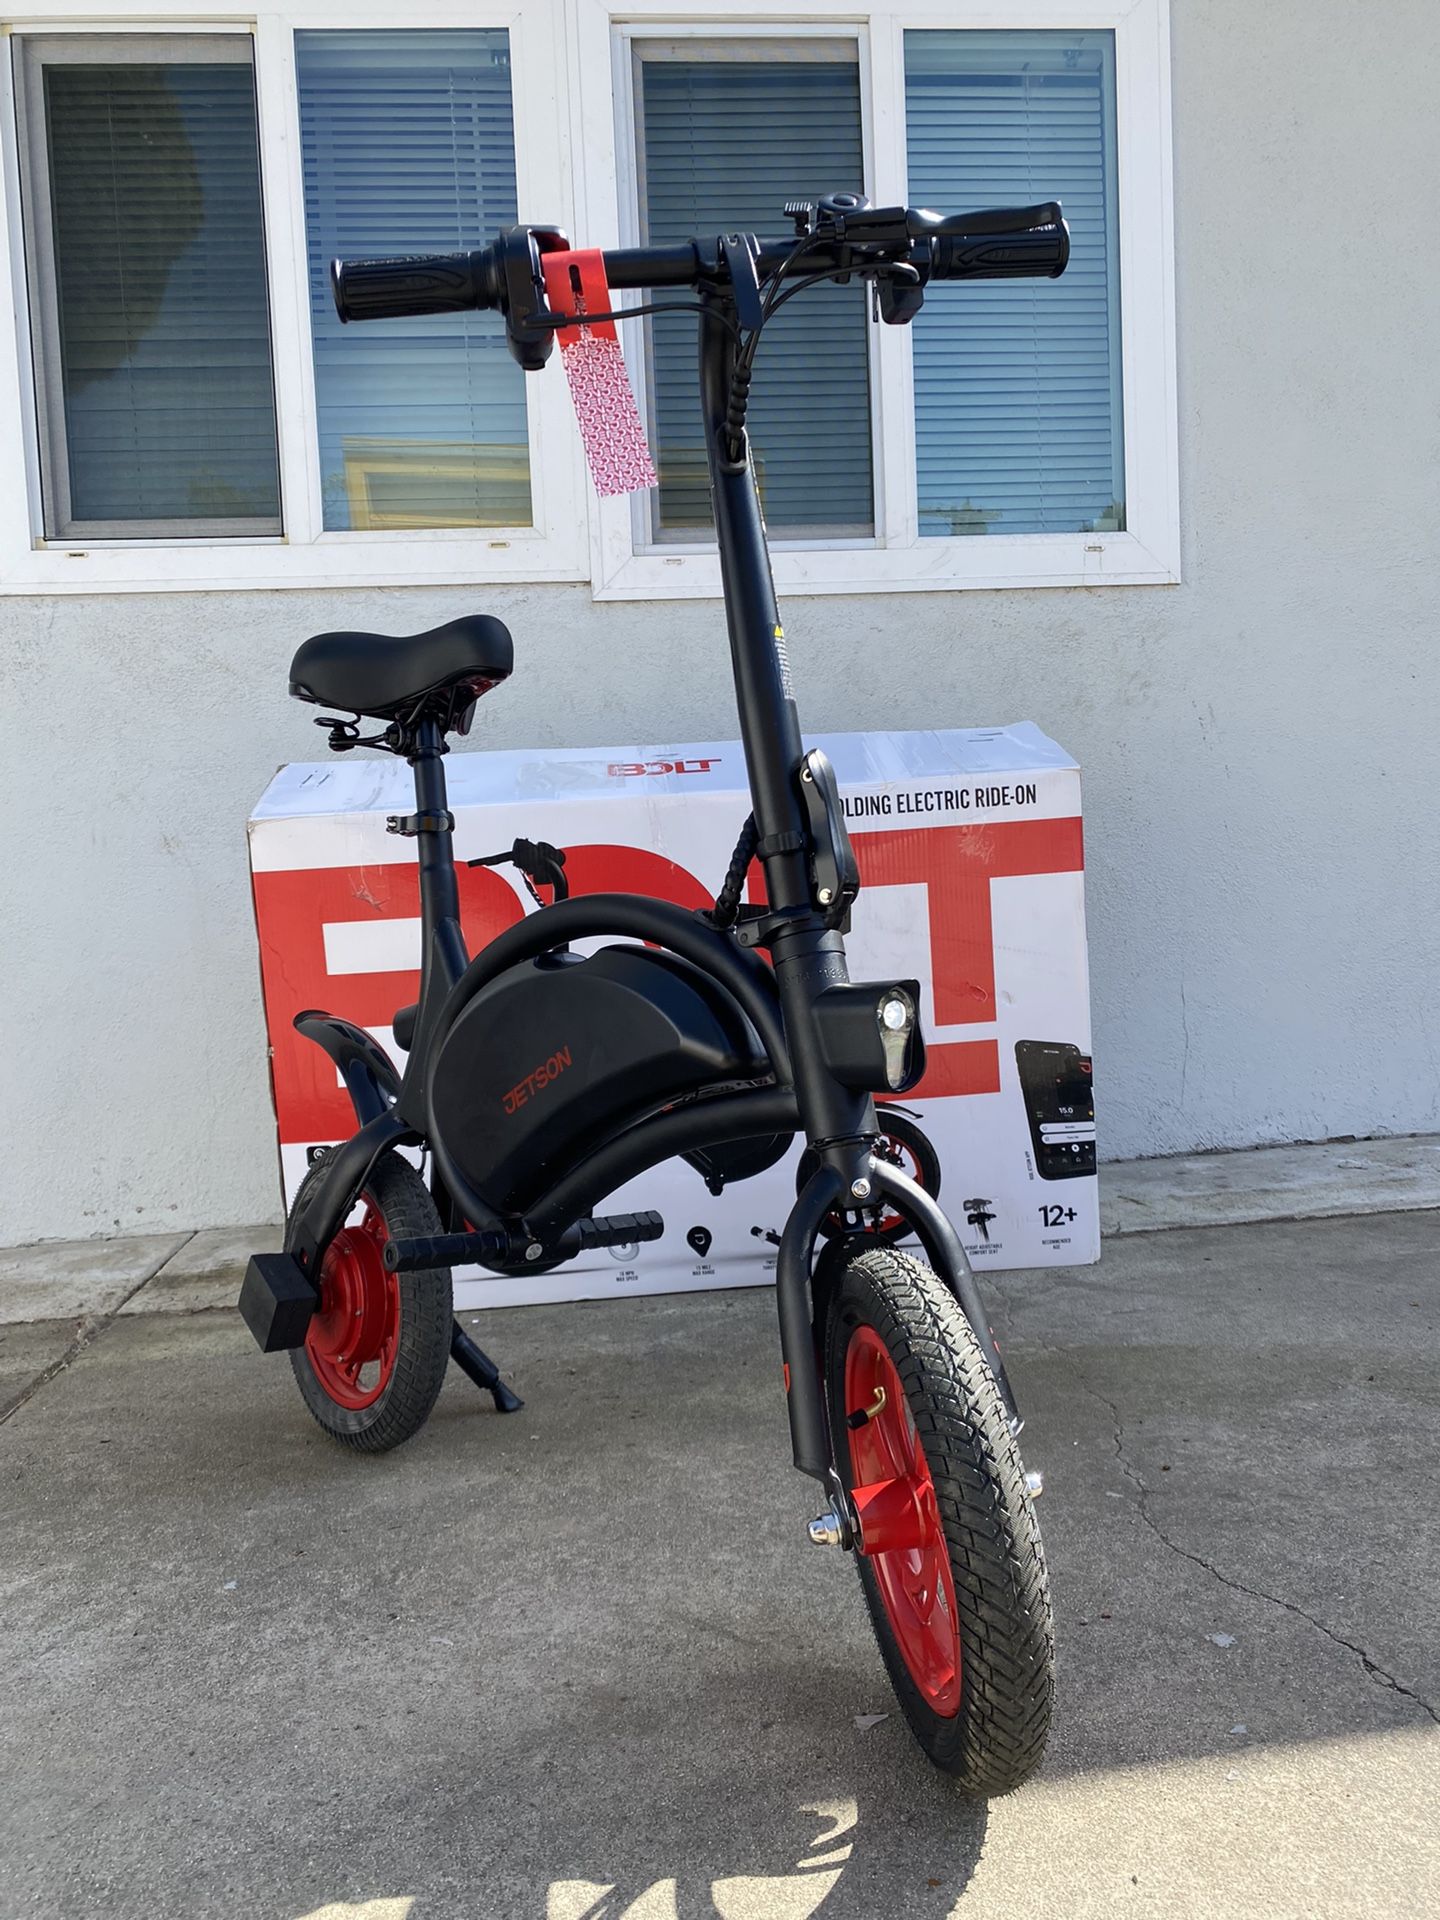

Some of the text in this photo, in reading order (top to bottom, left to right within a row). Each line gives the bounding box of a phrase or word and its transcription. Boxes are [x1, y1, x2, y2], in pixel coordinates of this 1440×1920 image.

[607, 759, 722, 777] BOLT
[838, 783, 1037, 818] LDING ELECTRIC RIDE-ON
[251, 816, 1085, 1144] BT
[502, 1044, 573, 1114] JETSON
[1038, 1204, 1078, 1228] 12+
